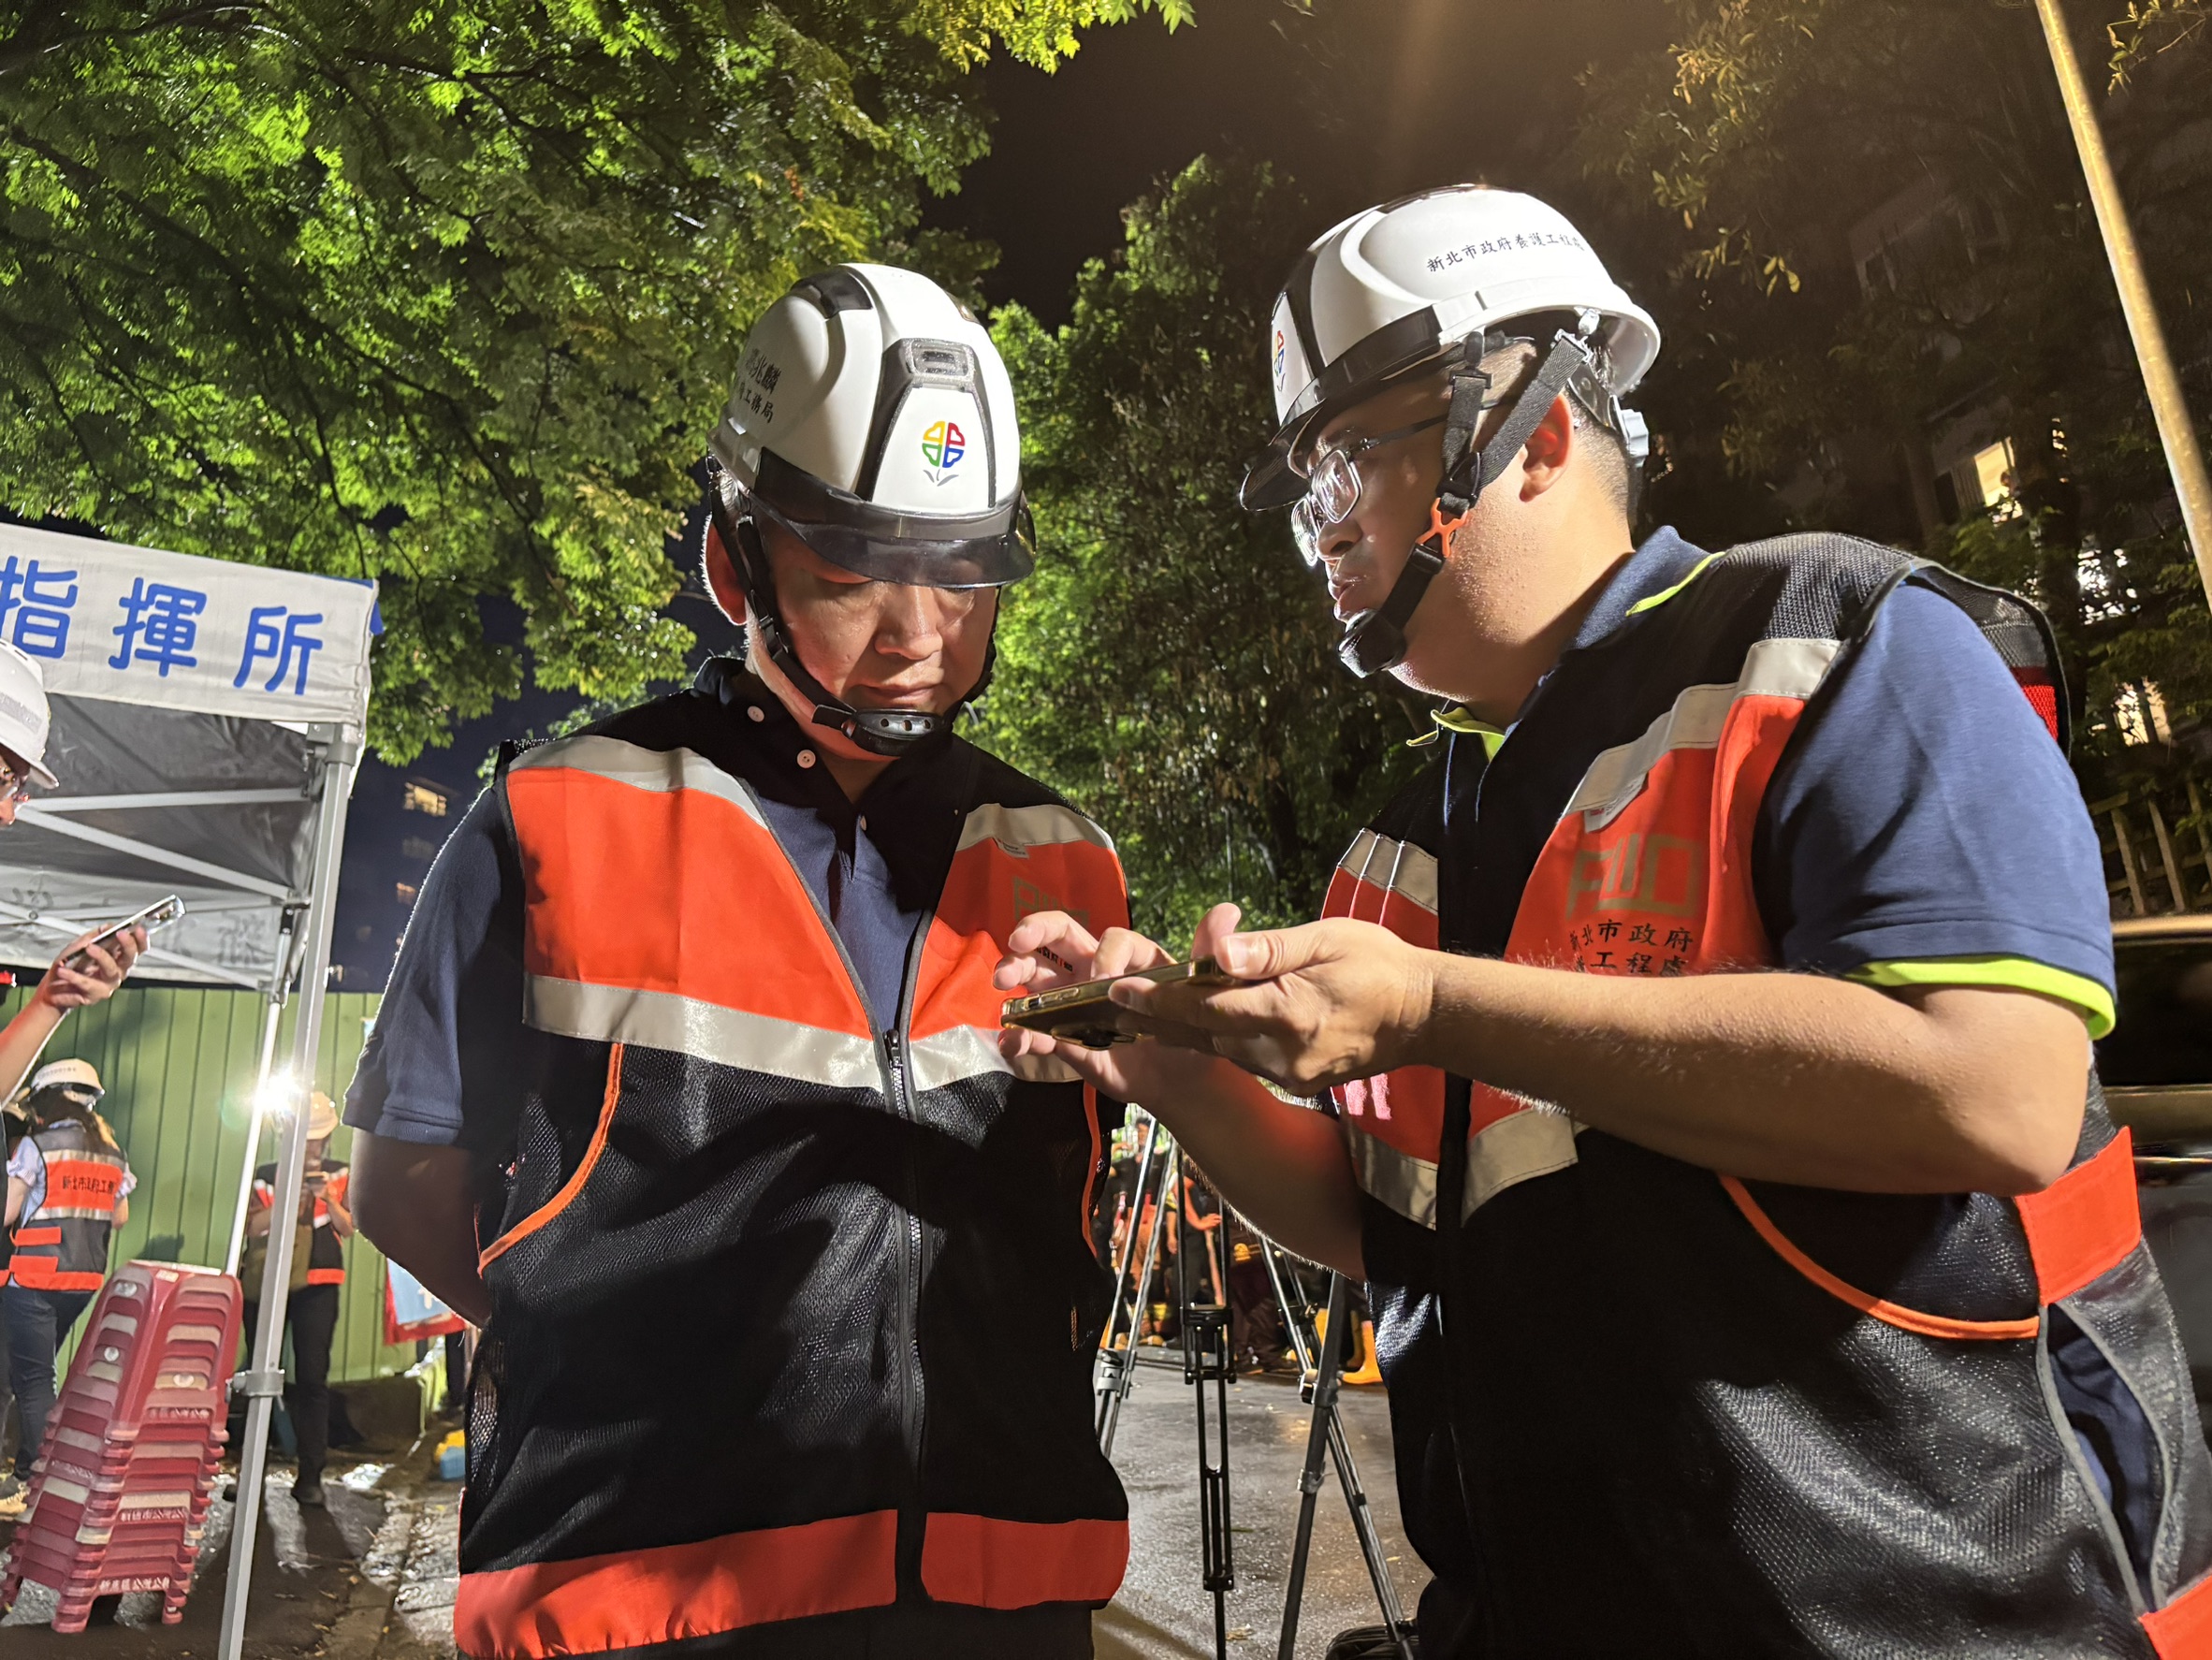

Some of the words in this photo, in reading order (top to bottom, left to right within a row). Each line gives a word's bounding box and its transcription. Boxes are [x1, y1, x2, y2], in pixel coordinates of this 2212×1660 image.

[0, 555, 324, 696] 指揮所
[1576, 951, 1687, 976] 工程處
